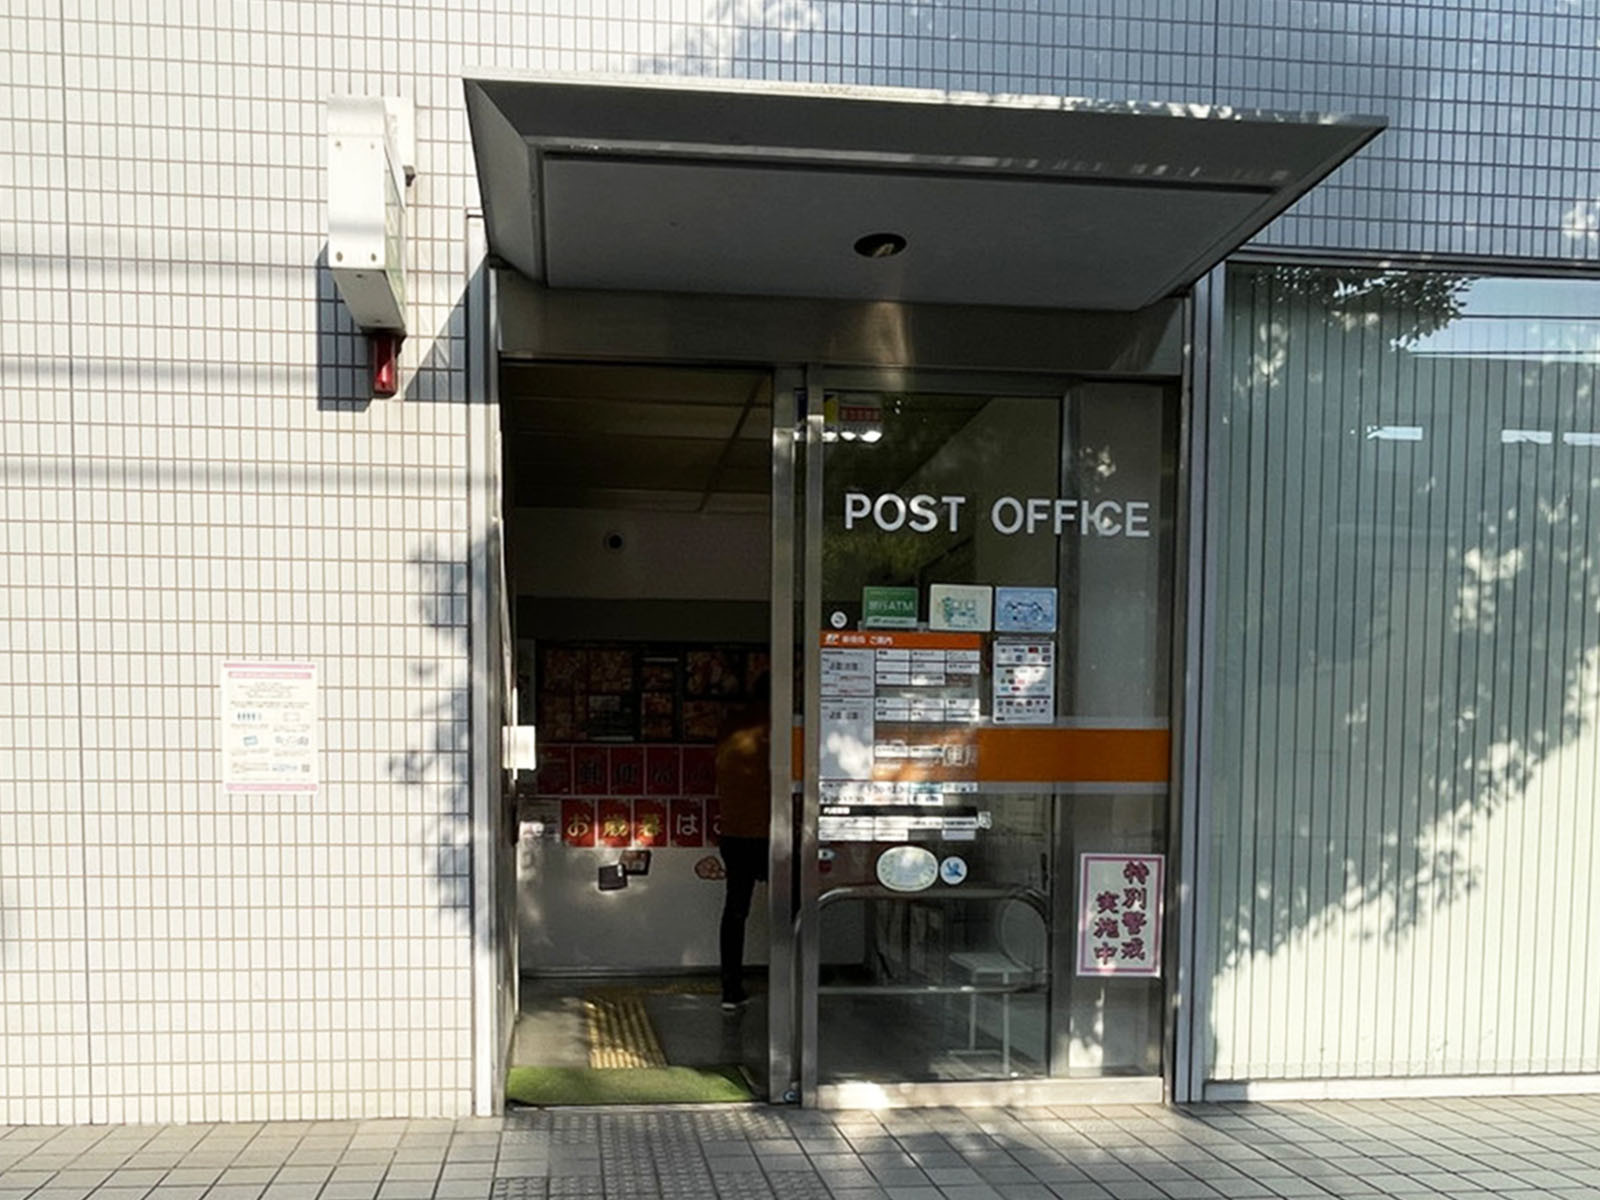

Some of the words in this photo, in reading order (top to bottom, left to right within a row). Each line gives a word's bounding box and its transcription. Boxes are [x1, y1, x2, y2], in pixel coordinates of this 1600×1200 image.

[845, 493, 966, 532] POST
[991, 496, 1150, 537] OFFICE
[1094, 891, 1119, 966] 実施中
[1121, 861, 1150, 961] 特別警戒
